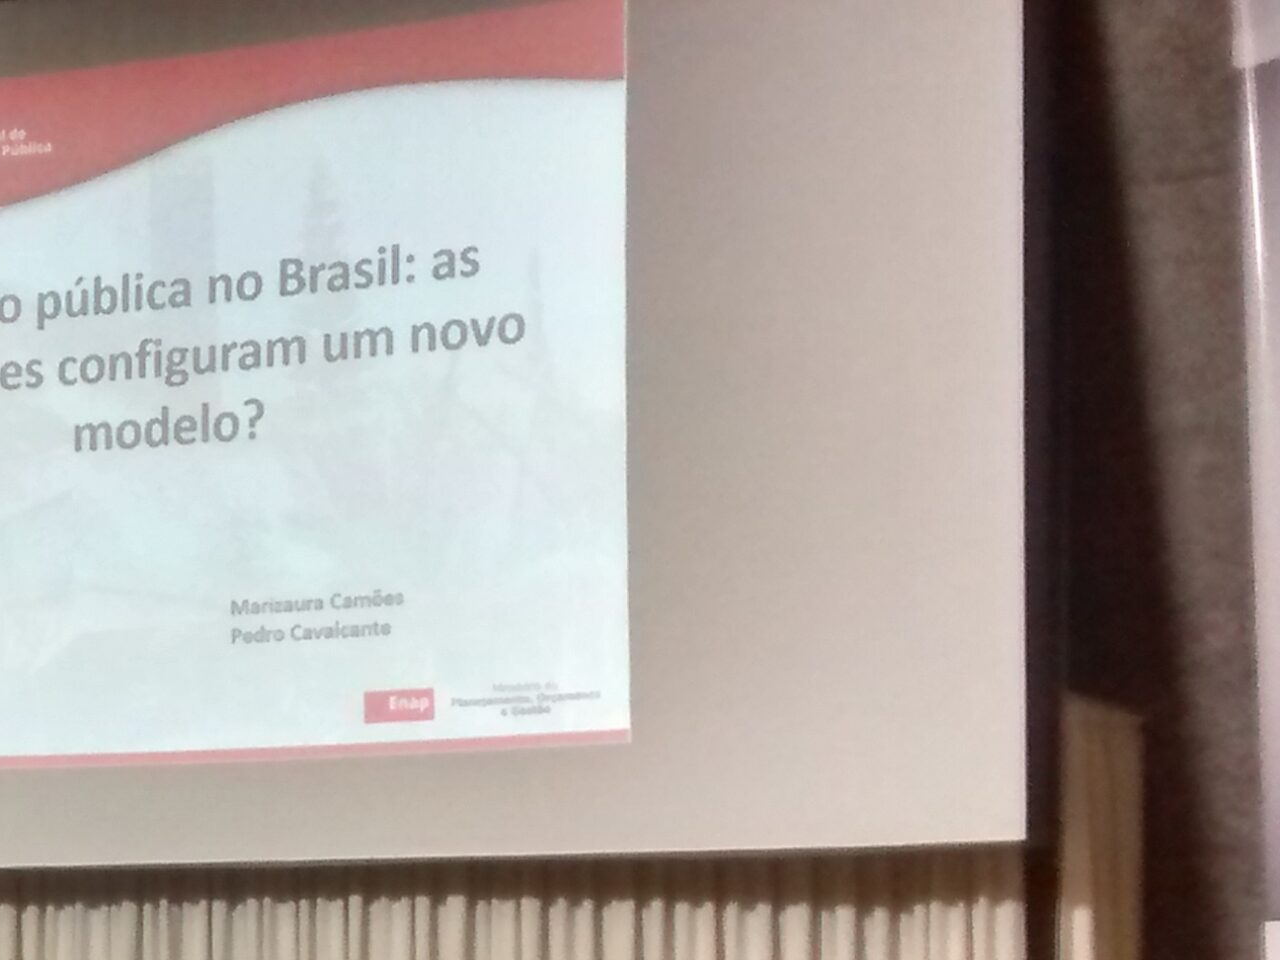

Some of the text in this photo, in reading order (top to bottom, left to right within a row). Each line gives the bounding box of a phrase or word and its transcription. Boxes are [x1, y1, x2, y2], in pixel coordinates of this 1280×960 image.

[9, 128, 27, 141] de
[36, 272, 192, 331] pública
[208, 268, 263, 304] no
[278, 243, 416, 297] Brasil:
[431, 243, 481, 282] as
[57, 334, 307, 387] configuram
[322, 326, 394, 362] um
[411, 311, 526, 354] novo
[73, 398, 265, 453] modelo?
[230, 589, 405, 616] Marizaura Camões
[231, 620, 392, 644] Pedro Cavalcante
[389, 695, 430, 713] Enap
